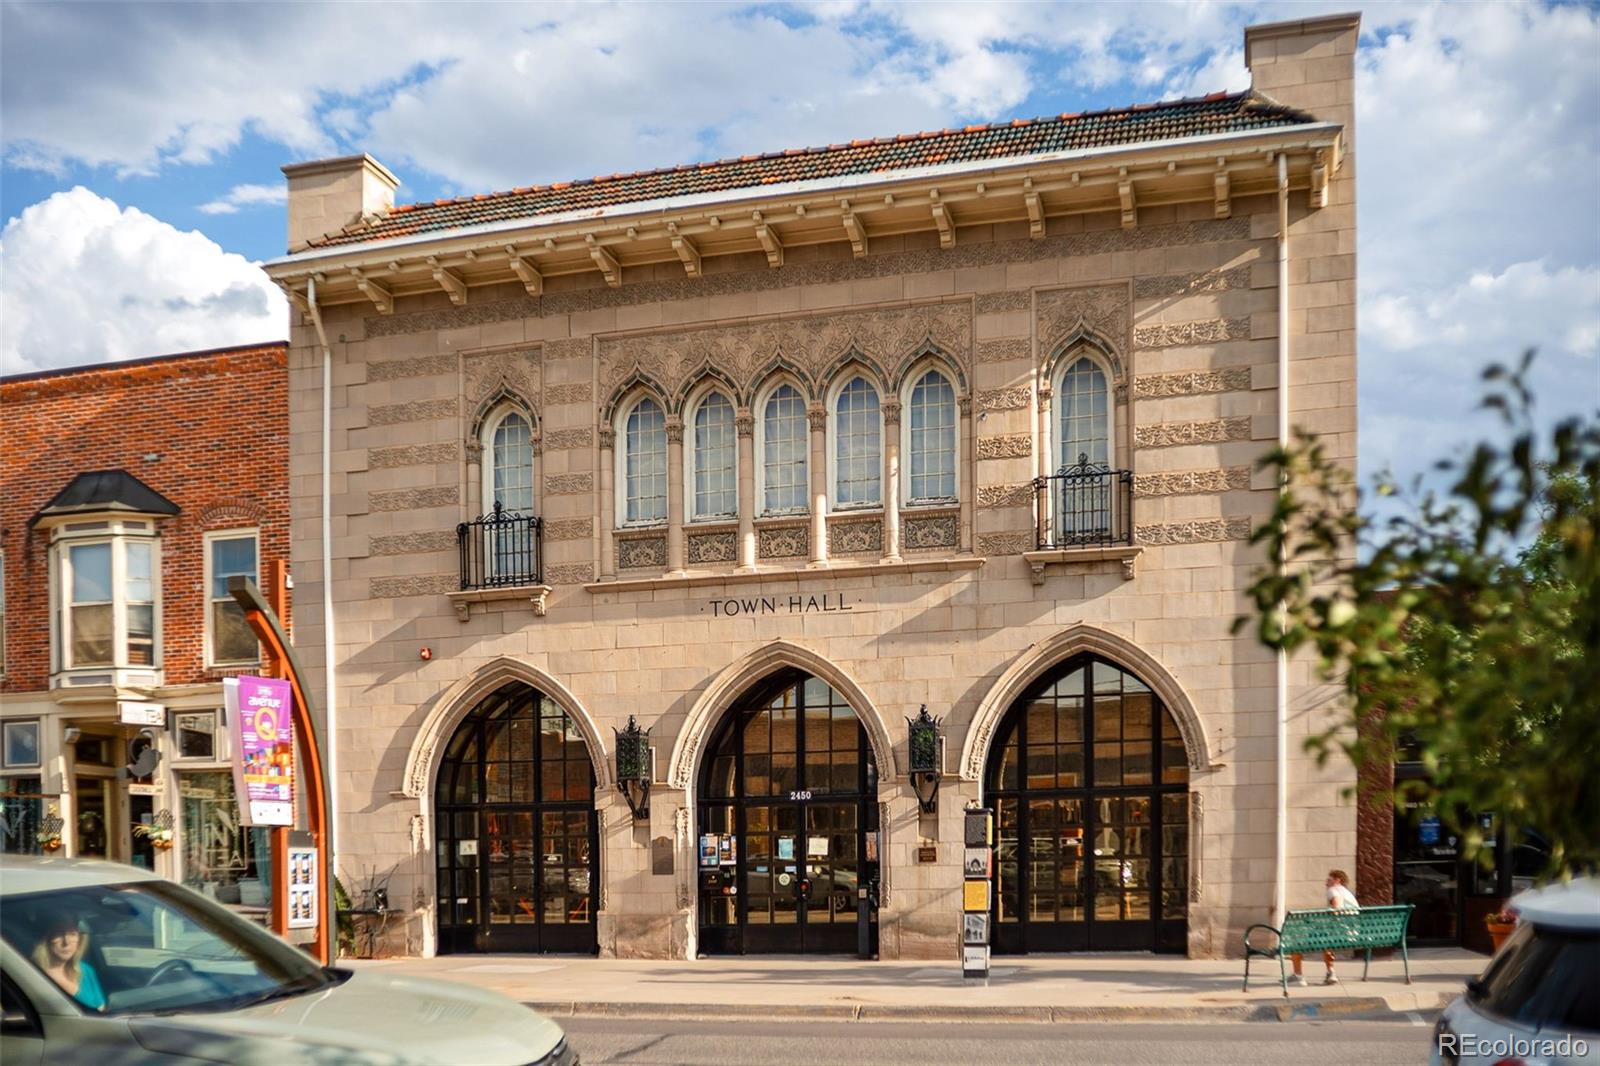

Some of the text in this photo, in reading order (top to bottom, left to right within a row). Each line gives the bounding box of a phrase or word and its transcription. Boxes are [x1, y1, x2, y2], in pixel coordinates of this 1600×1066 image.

[709, 593, 853, 617] TOWN HALL
[255, 707, 279, 741] Q
[790, 791, 812, 800] 2450
